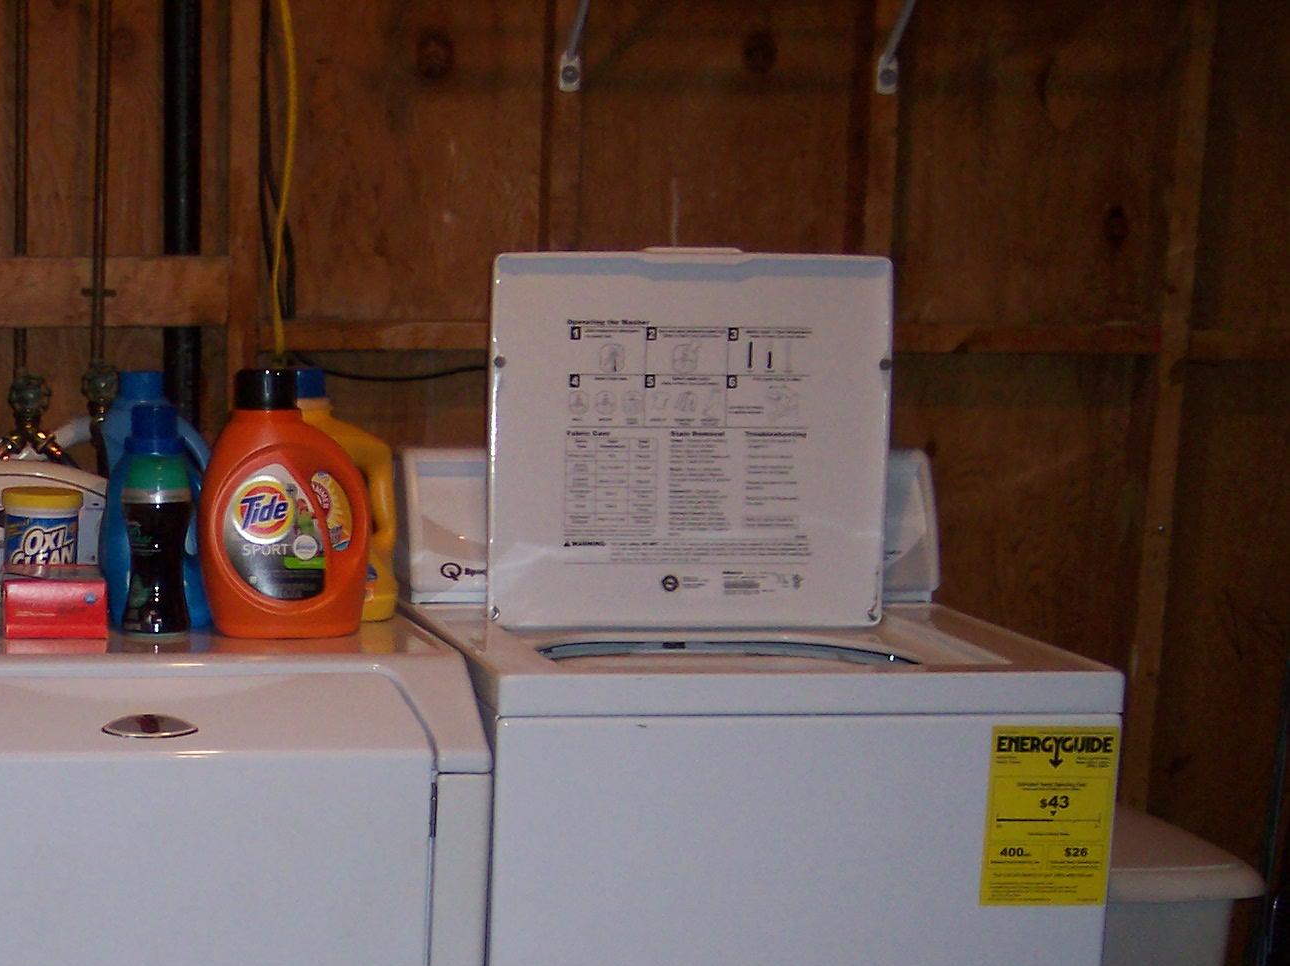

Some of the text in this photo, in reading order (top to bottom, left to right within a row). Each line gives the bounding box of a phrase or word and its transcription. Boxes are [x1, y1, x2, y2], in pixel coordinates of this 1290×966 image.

[240, 494, 289, 531] Tide
[22, 526, 67, 556] OXI
[242, 543, 289, 556] SPORT
[997, 735, 1114, 755] ENERGYGUIDE
[1039, 795, 1070, 809] $43
[999, 847, 1024, 857] 400
